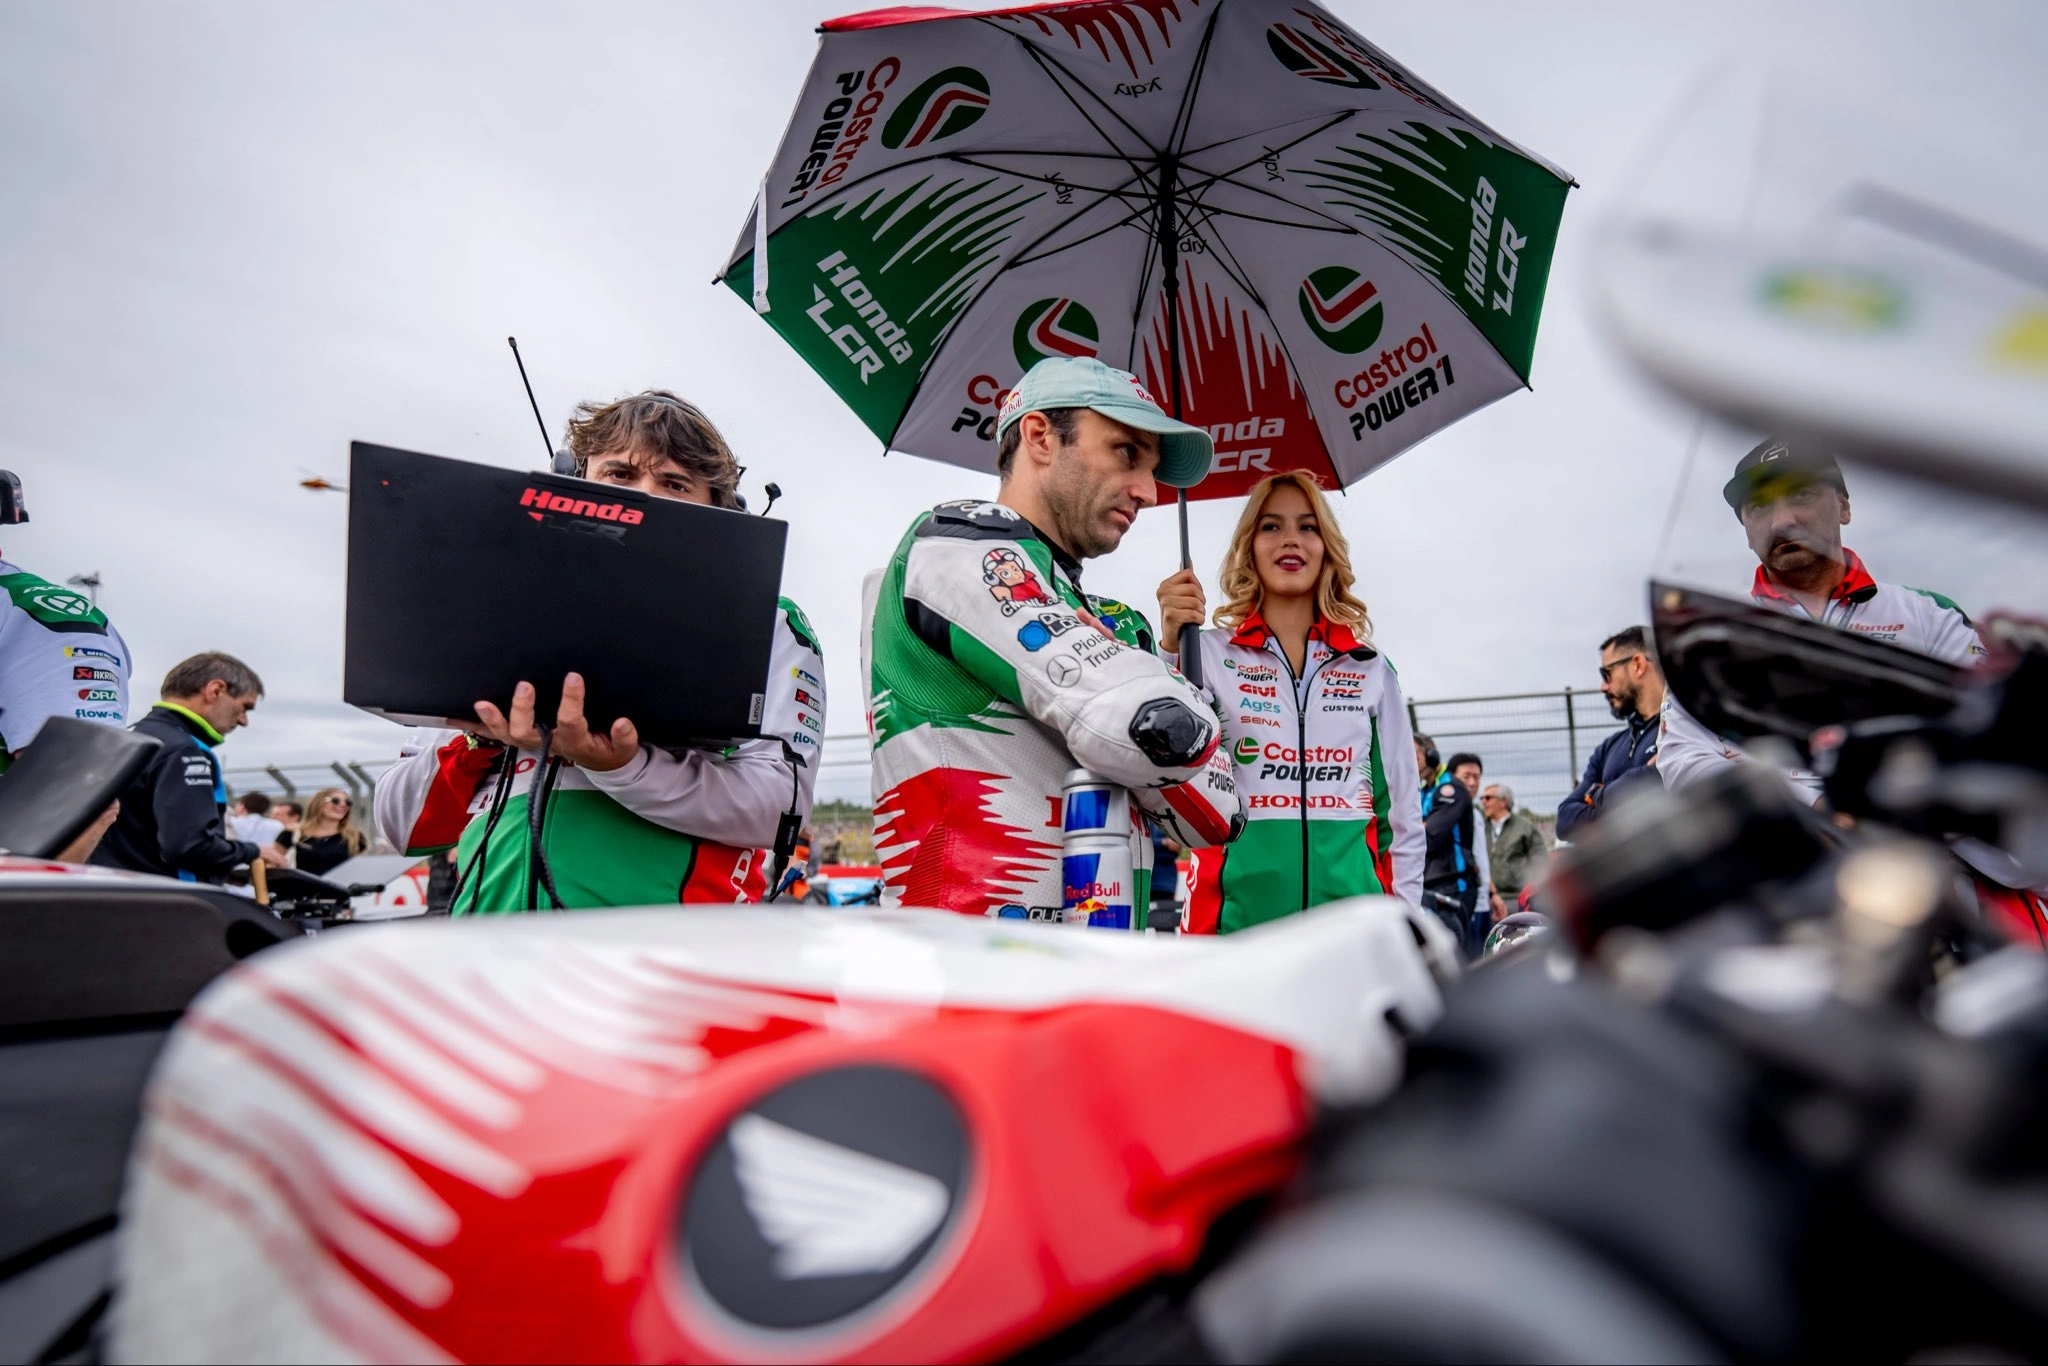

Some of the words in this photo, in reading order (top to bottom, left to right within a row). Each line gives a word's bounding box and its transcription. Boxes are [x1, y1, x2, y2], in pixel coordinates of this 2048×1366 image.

[815, 56, 901, 191] Castrol
[780, 70, 865, 209] POWER1
[1464, 175, 1498, 308] Honda
[1493, 216, 1528, 317] LCR
[816, 250, 914, 365] Honda
[805, 283, 885, 386] LCR
[1334, 322, 1438, 409] Castrol
[1349, 354, 1455, 442] POWER1
[1198, 415, 1285, 443] nda
[1209, 447, 1273, 474] CR
[520, 488, 644, 525] Honda
[1072, 634, 1107, 656] Piola
[1869, 632, 1897, 641] CR
[1084, 643, 1124, 667] Truck
[1238, 664, 1277, 676] Castrol
[1238, 683, 1277, 698] GIVI
[1321, 688, 1363, 699] HRC
[1326, 678, 1361, 688] LCR
[752, 697, 761, 721] Lenovo
[1239, 697, 1281, 714] Agos
[1240, 715, 1281, 728] SENA
[1263, 742, 1353, 763] Castrol
[1259, 763, 1352, 783] POWER1
[1248, 795, 1352, 809] HONDA
[1065, 882, 1090, 900] Red
[1092, 882, 1120, 897] Bull
